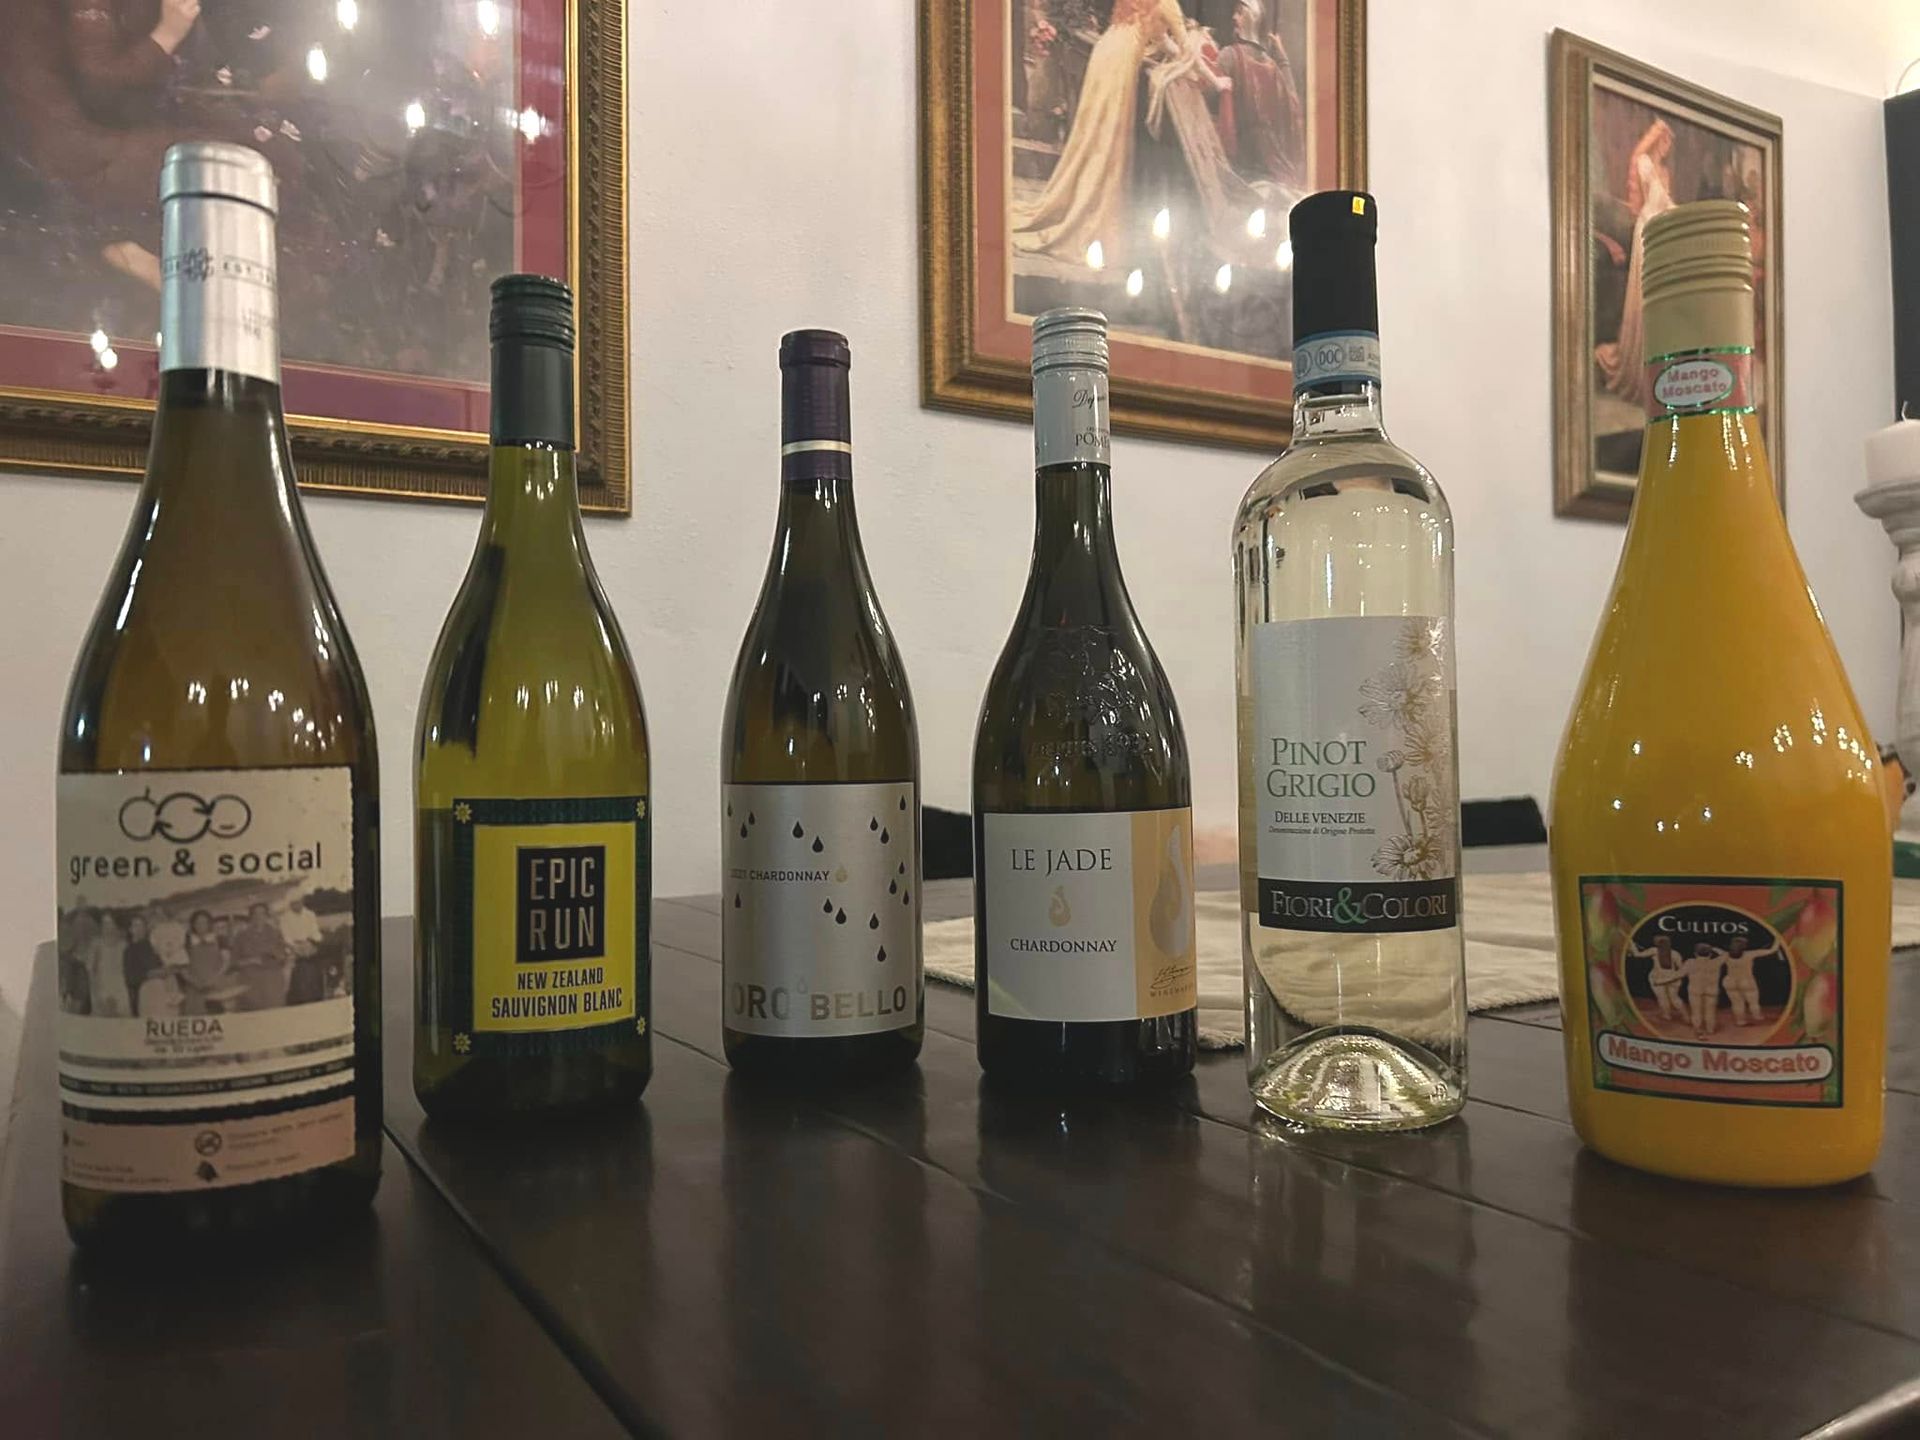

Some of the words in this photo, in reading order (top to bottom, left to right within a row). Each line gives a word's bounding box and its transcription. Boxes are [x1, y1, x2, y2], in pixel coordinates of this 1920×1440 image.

[1318, 349, 1341, 365] DOC
[1663, 380, 1727, 397] Moscato
[1668, 368, 1719, 383] Mango
[1271, 737, 1367, 766] PINOT
[1266, 769, 1376, 798] GRIGIO
[1275, 810, 1310, 823] DELLE
[1311, 812, 1366, 824] VENEZIE
[69, 854, 151, 885] green
[171, 849, 195, 877] &
[217, 842, 321, 875] social
[1011, 848, 1035, 871] LE
[1045, 848, 1112, 877] JADE
[530, 856, 596, 900] EPIC
[749, 870, 830, 882] CHARDONNAY
[529, 906, 595, 951] RUN
[1657, 915, 1749, 934] CULITOS
[1010, 938, 1117, 953] CHARDONNAY
[517, 972, 547, 990] NEW
[552, 967, 604, 989] ZEALAND
[492, 992, 578, 1019] SAUVIGNON
[583, 988, 622, 1013] BLANC
[810, 984, 907, 1021] BELLO
[146, 1018, 224, 1038] RUEDA
[1608, 1036, 1692, 1071] Mango
[1702, 1048, 1821, 1074] Moscato
